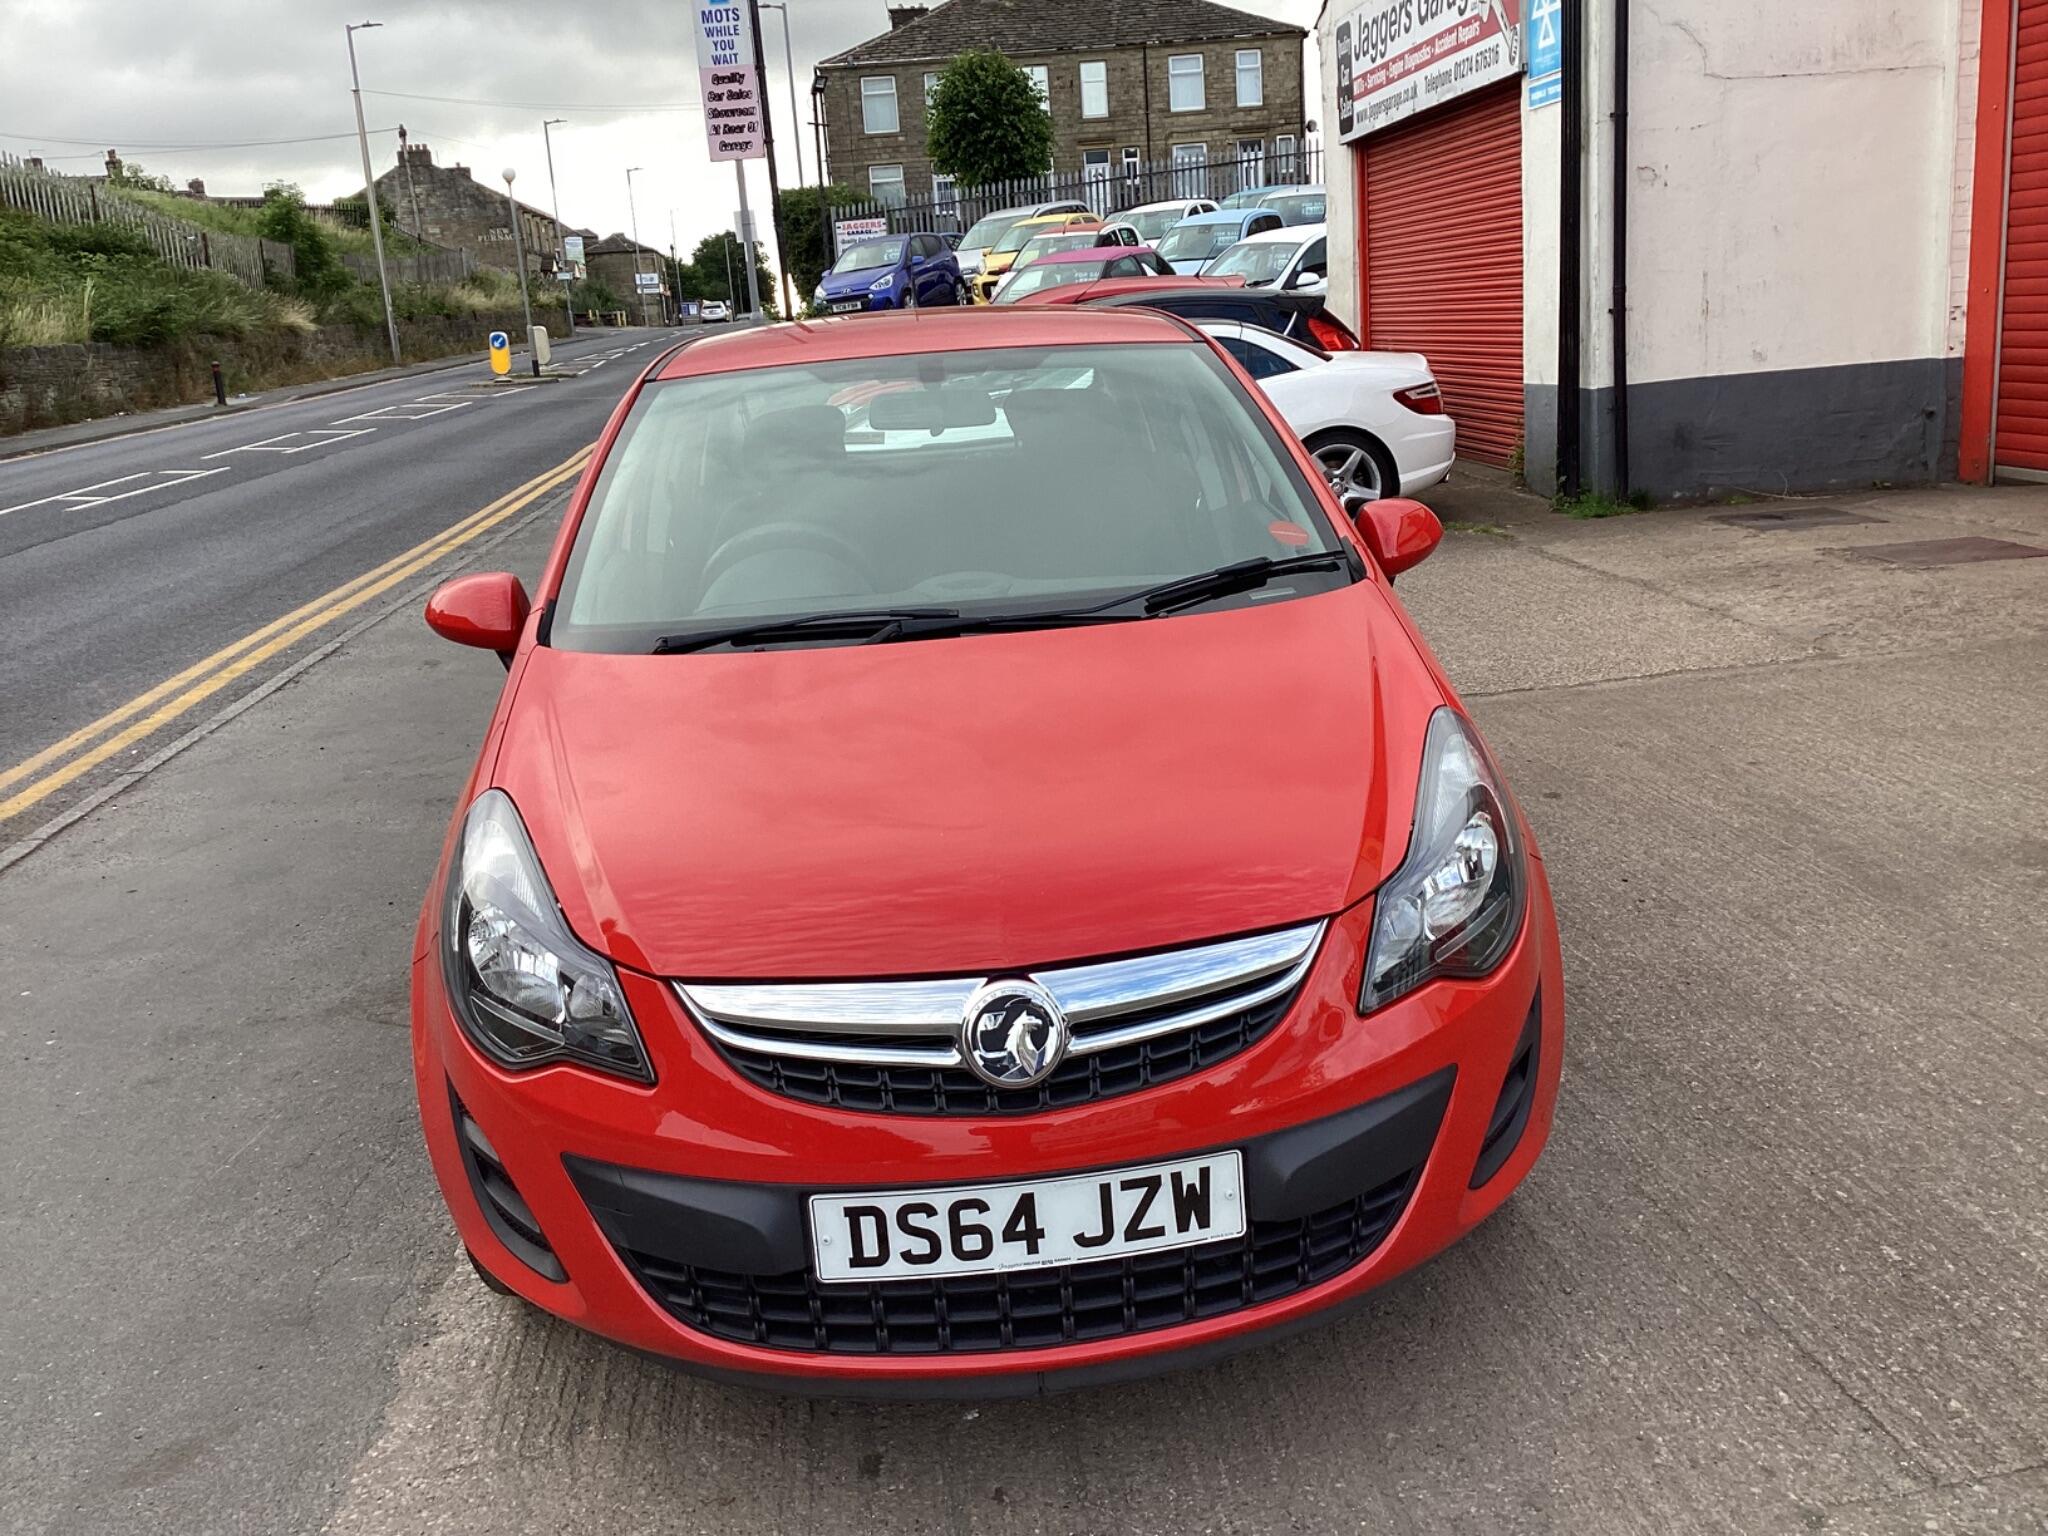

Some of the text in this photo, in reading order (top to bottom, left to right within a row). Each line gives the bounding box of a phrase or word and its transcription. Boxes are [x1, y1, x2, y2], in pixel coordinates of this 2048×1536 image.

[701, 8, 740, 24] MOTS
[704, 25, 740, 38] WHILE
[1353, 0, 1414, 63] Jaggers
[1458, 18, 1480, 45] Repairs
[712, 39, 735, 51] YOU
[711, 53, 739, 66] WAIT
[711, 72, 745, 85] Quality
[1424, 68, 1453, 94] Telephone
[1454, 54, 1473, 82] 01274
[708, 89, 753, 102] Car Sales
[719, 140, 754, 153] Garage
[842, 220, 882, 231] JAGGERS
[843, 1166, 1211, 1268] DS64 JZW
